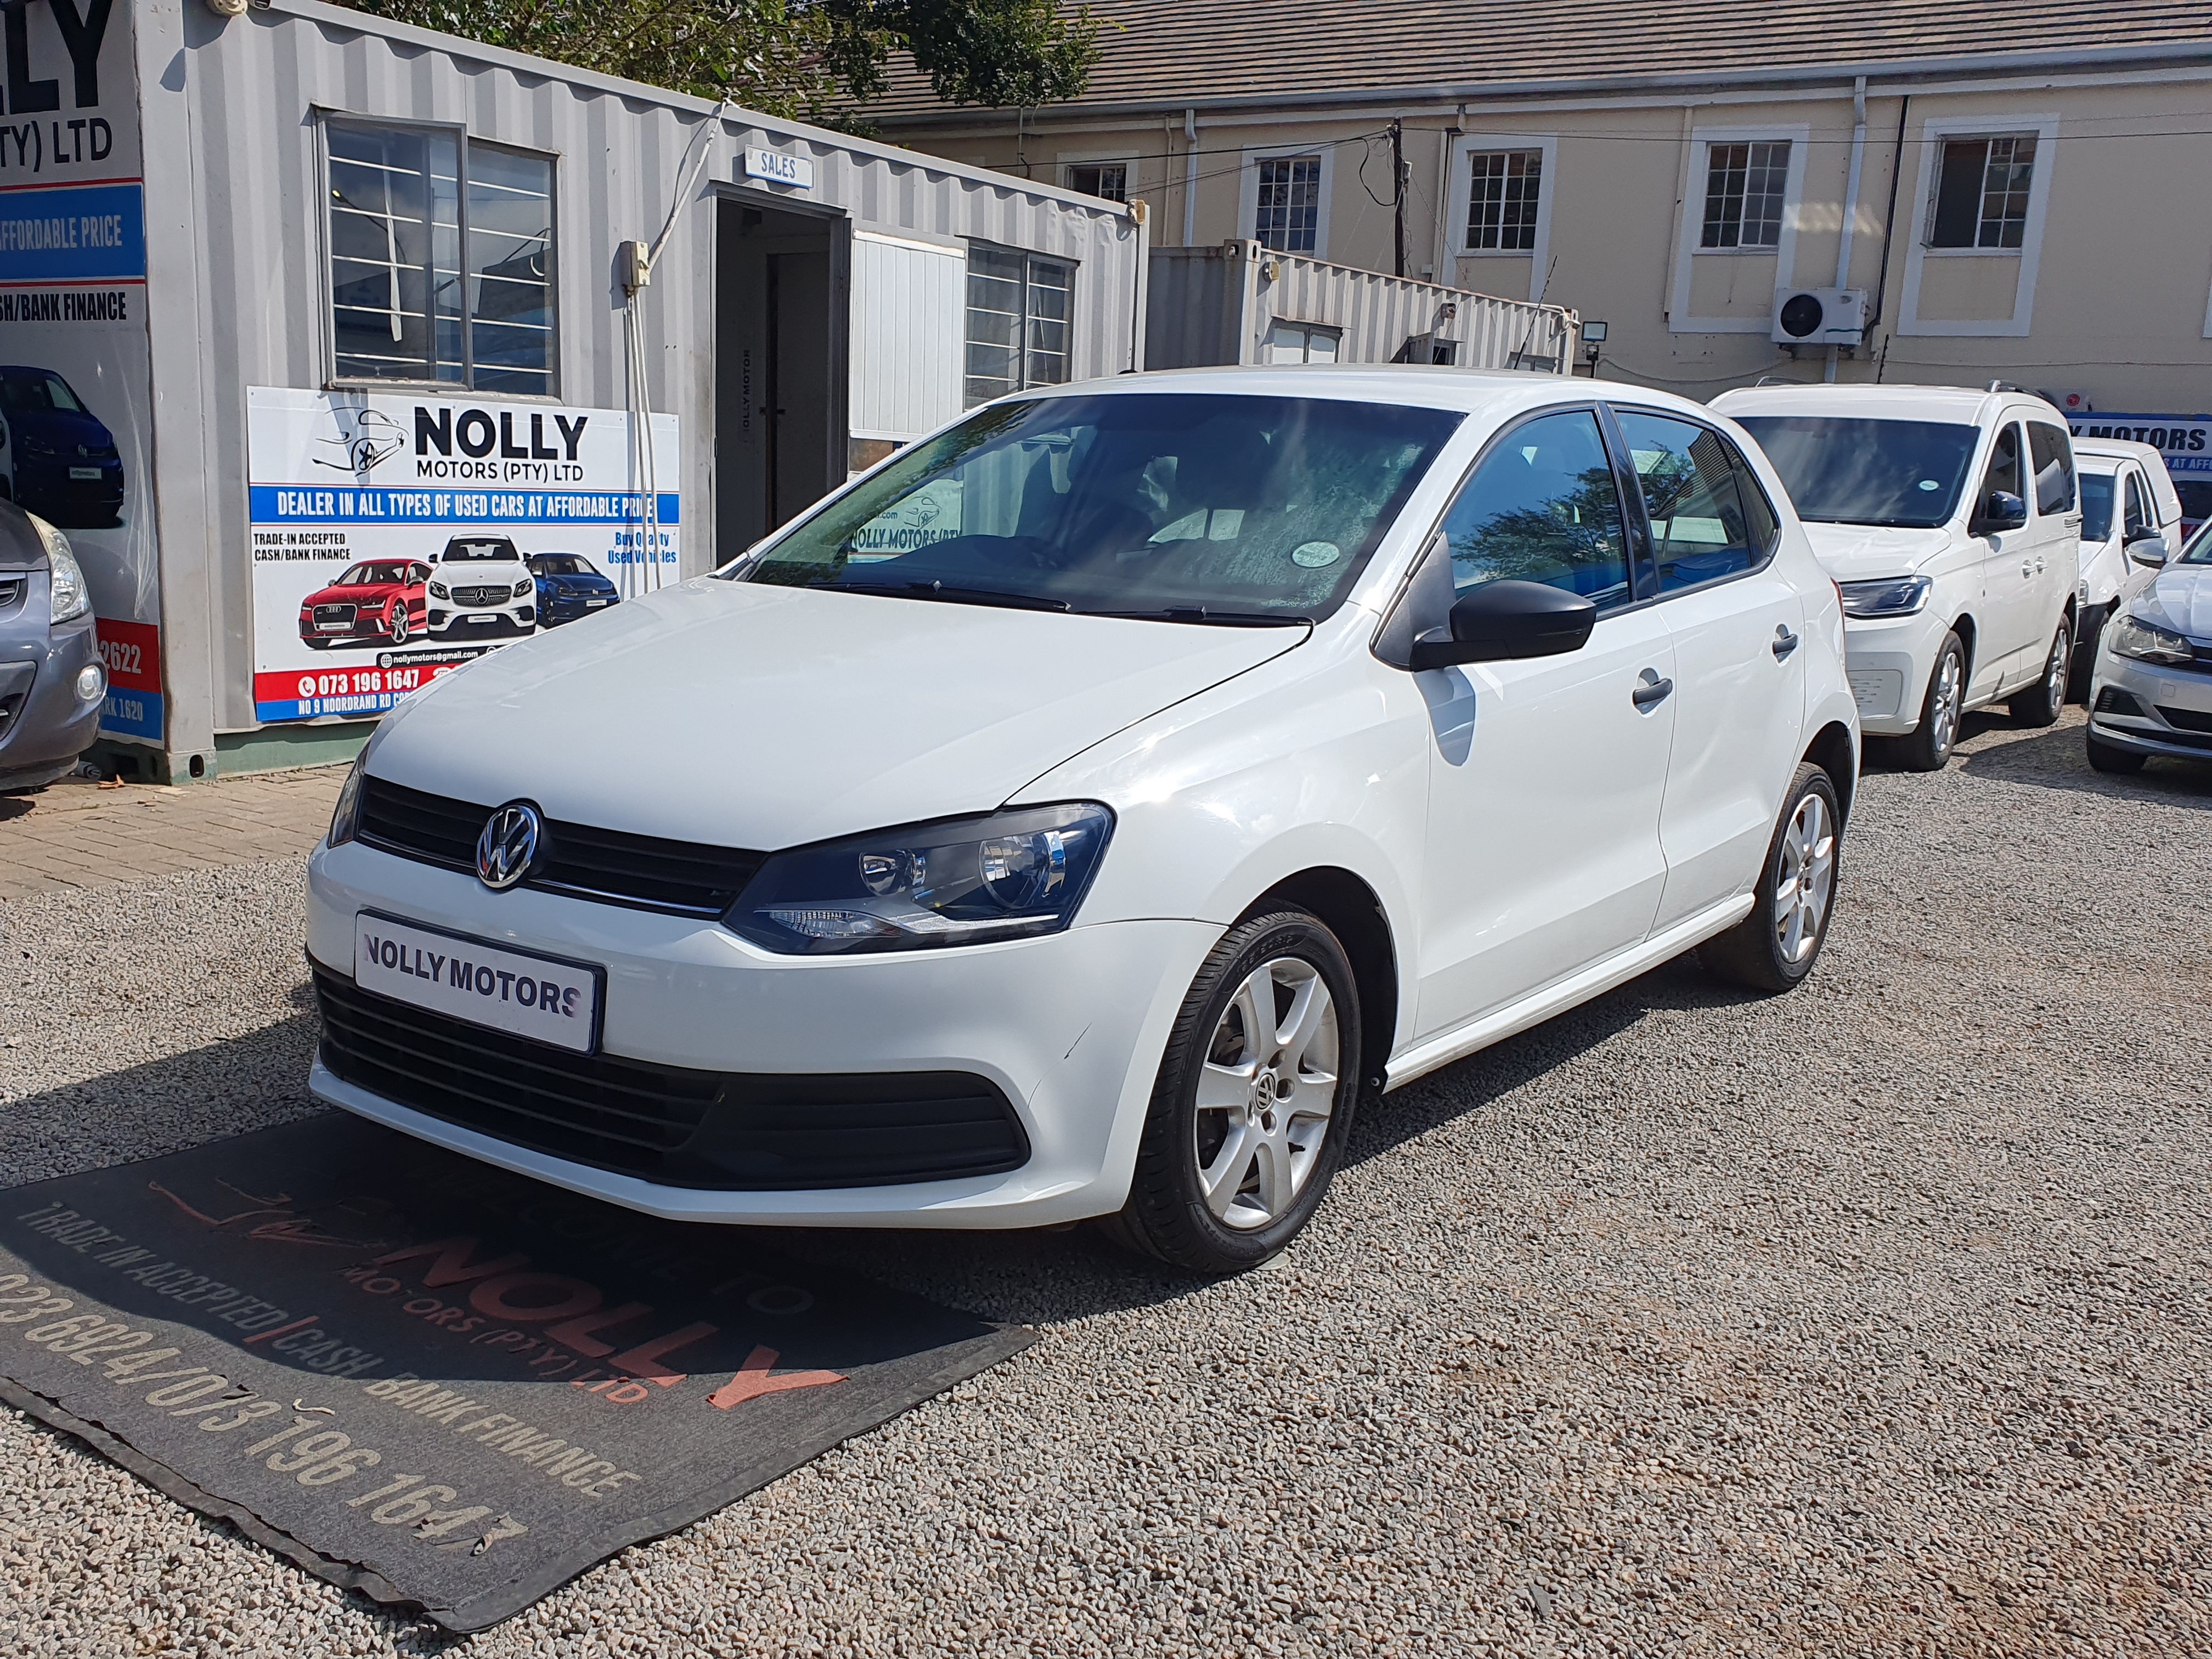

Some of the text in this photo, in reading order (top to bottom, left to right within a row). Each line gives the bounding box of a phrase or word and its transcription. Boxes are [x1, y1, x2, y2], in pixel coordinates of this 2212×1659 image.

[53, 117, 113, 163] LTD
[761, 152, 795, 179] SALES
[81, 215, 122, 247] PRICE
[63, 291, 127, 321] FINANCE
[414, 407, 589, 461] NOLLY
[417, 460, 583, 483] MOTORS (PTY) LTD
[2171, 458, 2186, 469] AT
[277, 491, 335, 516] DEALER
[339, 492, 354, 516] IN
[358, 493, 385, 516] ALL
[388, 493, 431, 517] TYPES
[435, 494, 451, 517] OF
[455, 494, 488, 516] USED
[491, 495, 524, 517] CARS
[528, 496, 544, 517] AT
[546, 496, 619, 517] AFFORDABLE
[253, 533, 346, 545] TRADE-IN ACCEPTED
[615, 532, 634, 548] Buy
[888, 528, 937, 549] MOTORS
[255, 549, 351, 561] CASH/BANK FINANCE
[608, 550, 633, 564] Used
[100, 640, 142, 674] 2622
[393, 650, 478, 664] nollymotors@gmail.com
[318, 669, 419, 695] 073 196 1647
[119, 698, 143, 721] 1620
[298, 699, 311, 715] NO
[314, 699, 320, 714] 9
[323, 695, 377, 713] NOORDRAND
[379, 693, 391, 708] RD
[364, 933, 583, 1019] NOLLY MOTORS
[372, 1235, 850, 1410] NOLLY
[15, 1201, 126, 1253] TRADE
[93, 1245, 156, 1268] IN
[363, 1372, 490, 1425] BANK
[459, 1413, 642, 1498] FINANCE
[245, 1414, 382, 1486] 196
